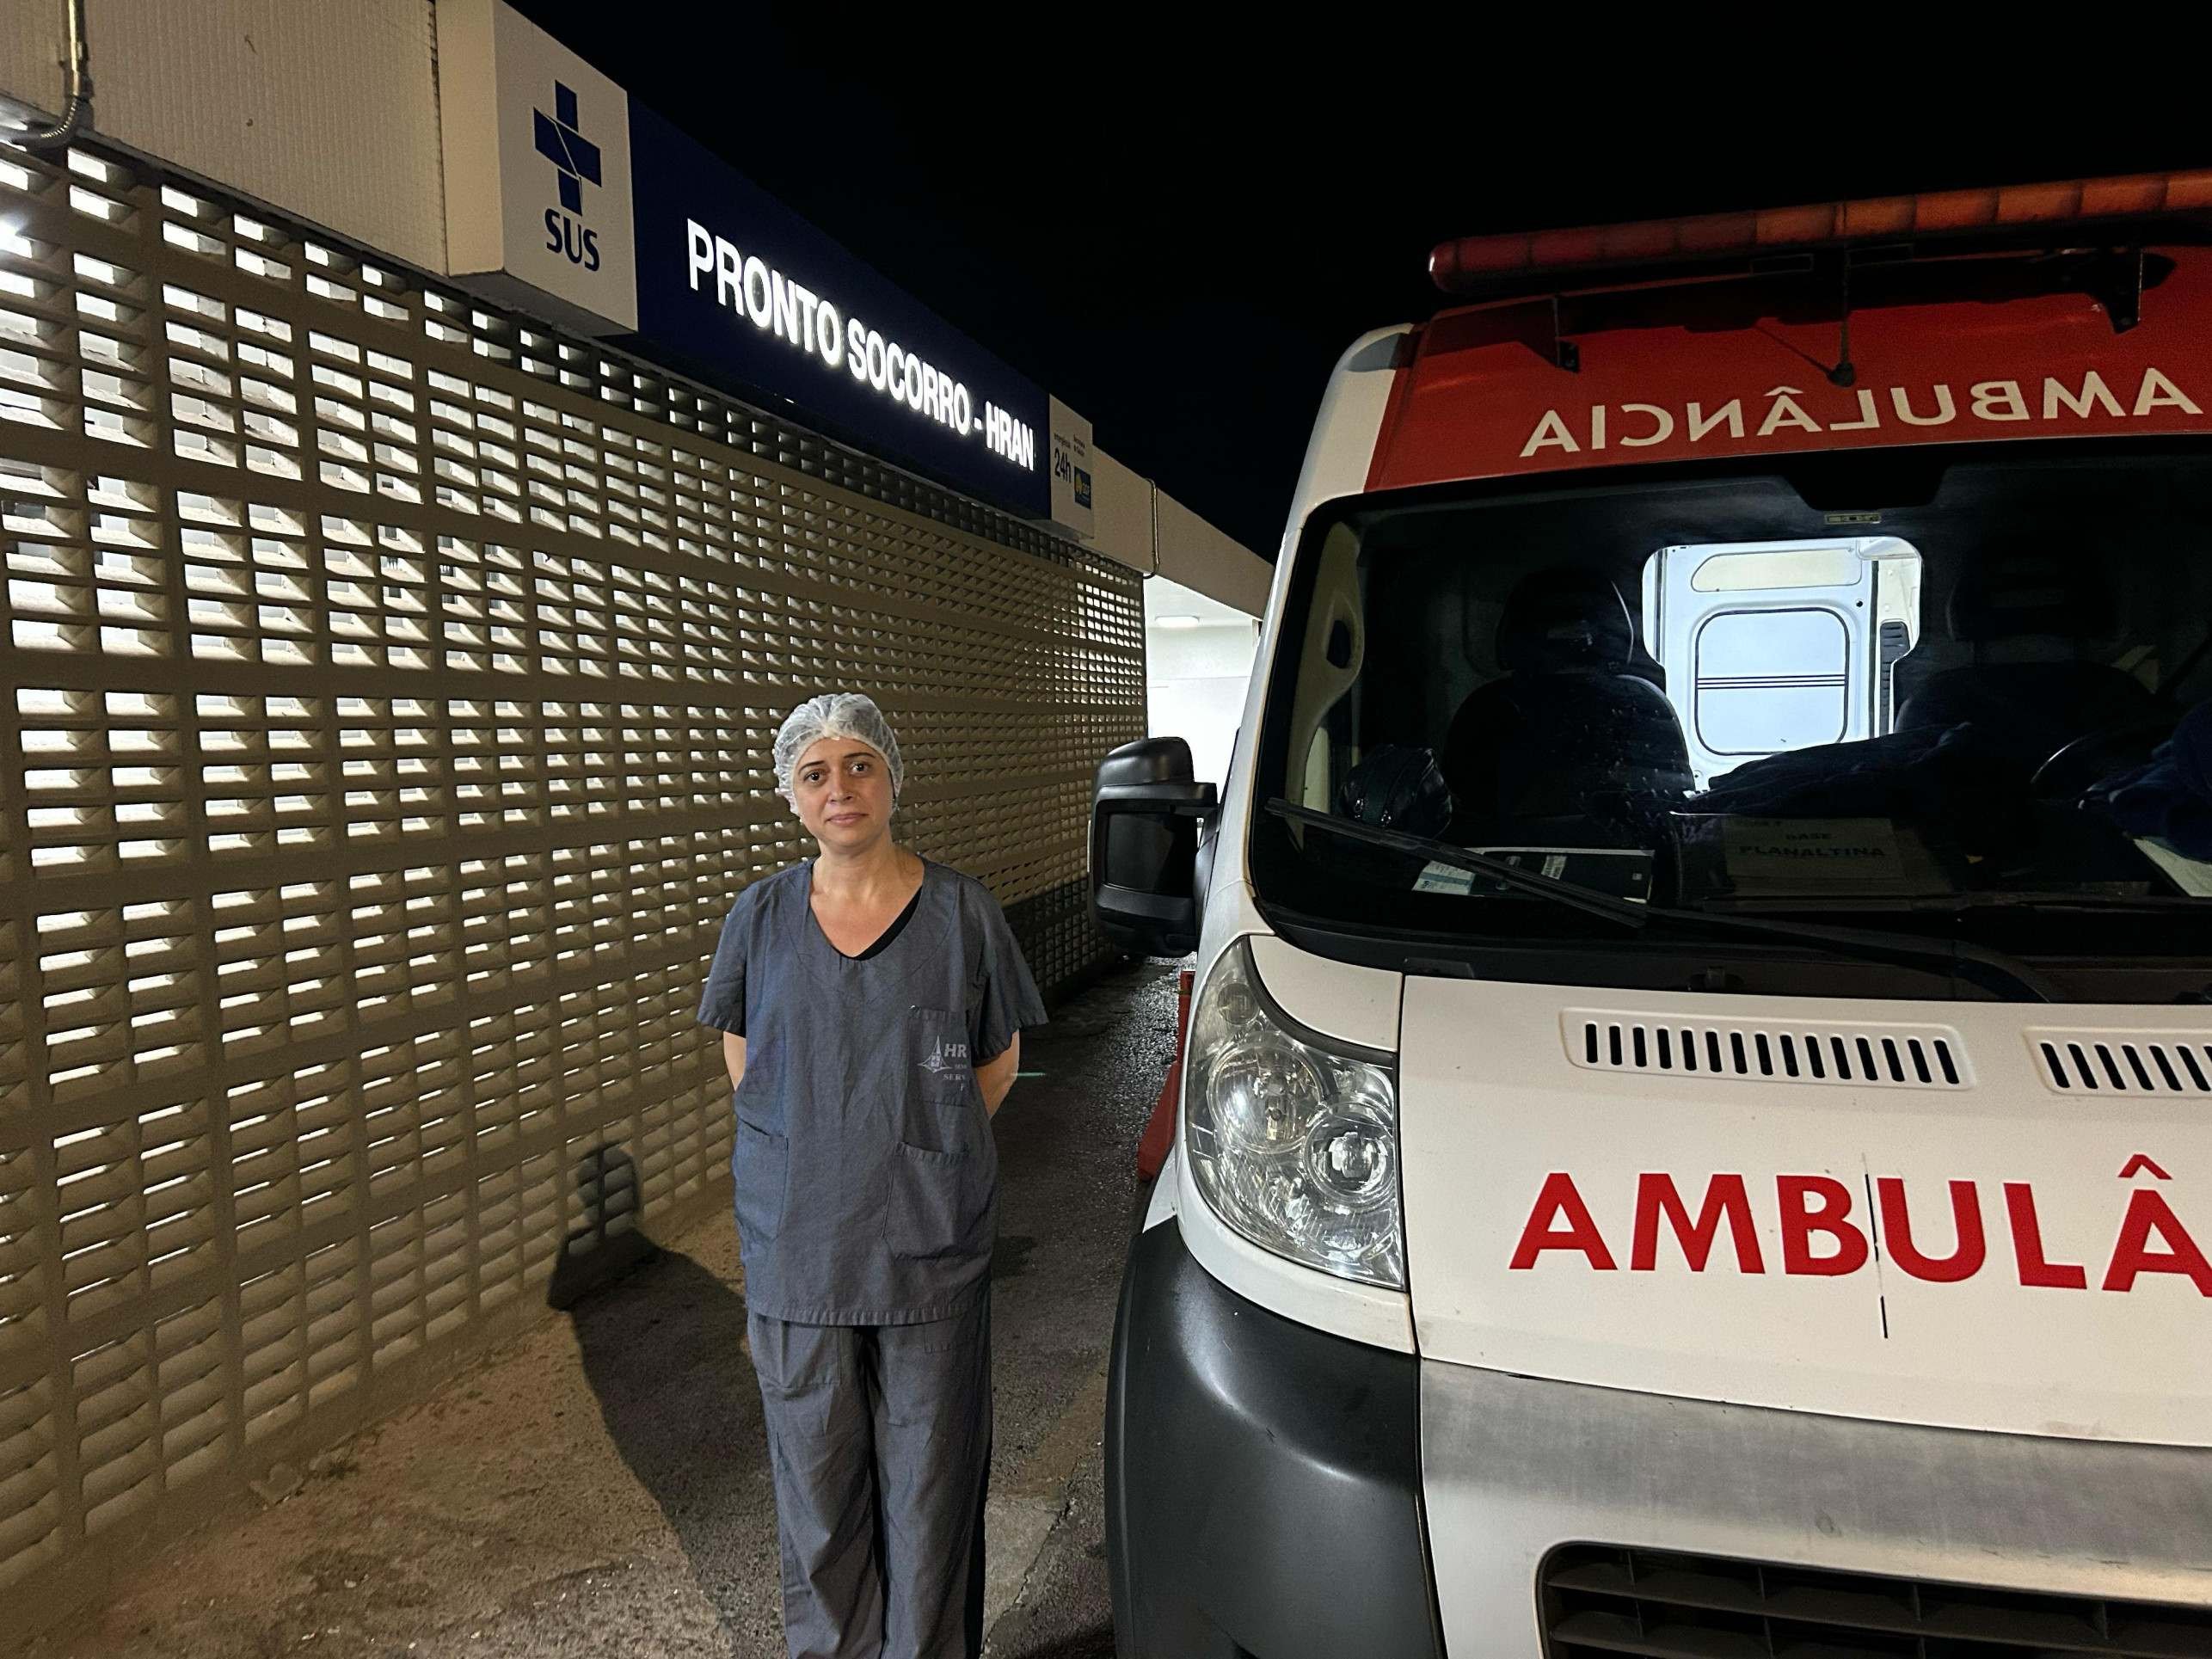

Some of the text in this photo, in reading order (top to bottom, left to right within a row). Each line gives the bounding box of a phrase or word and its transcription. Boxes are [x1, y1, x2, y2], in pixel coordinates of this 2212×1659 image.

[544, 208, 599, 272] SUS
[687, 218, 841, 366] PRONTO
[848, 318, 970, 435] SOCORRO
[986, 401, 1034, 471] HRAN
[1054, 447, 1072, 483] 24h
[1739, 845, 1886, 857] PLANALTINA
[1508, 1153, 2212, 1299] AMBULÂ
